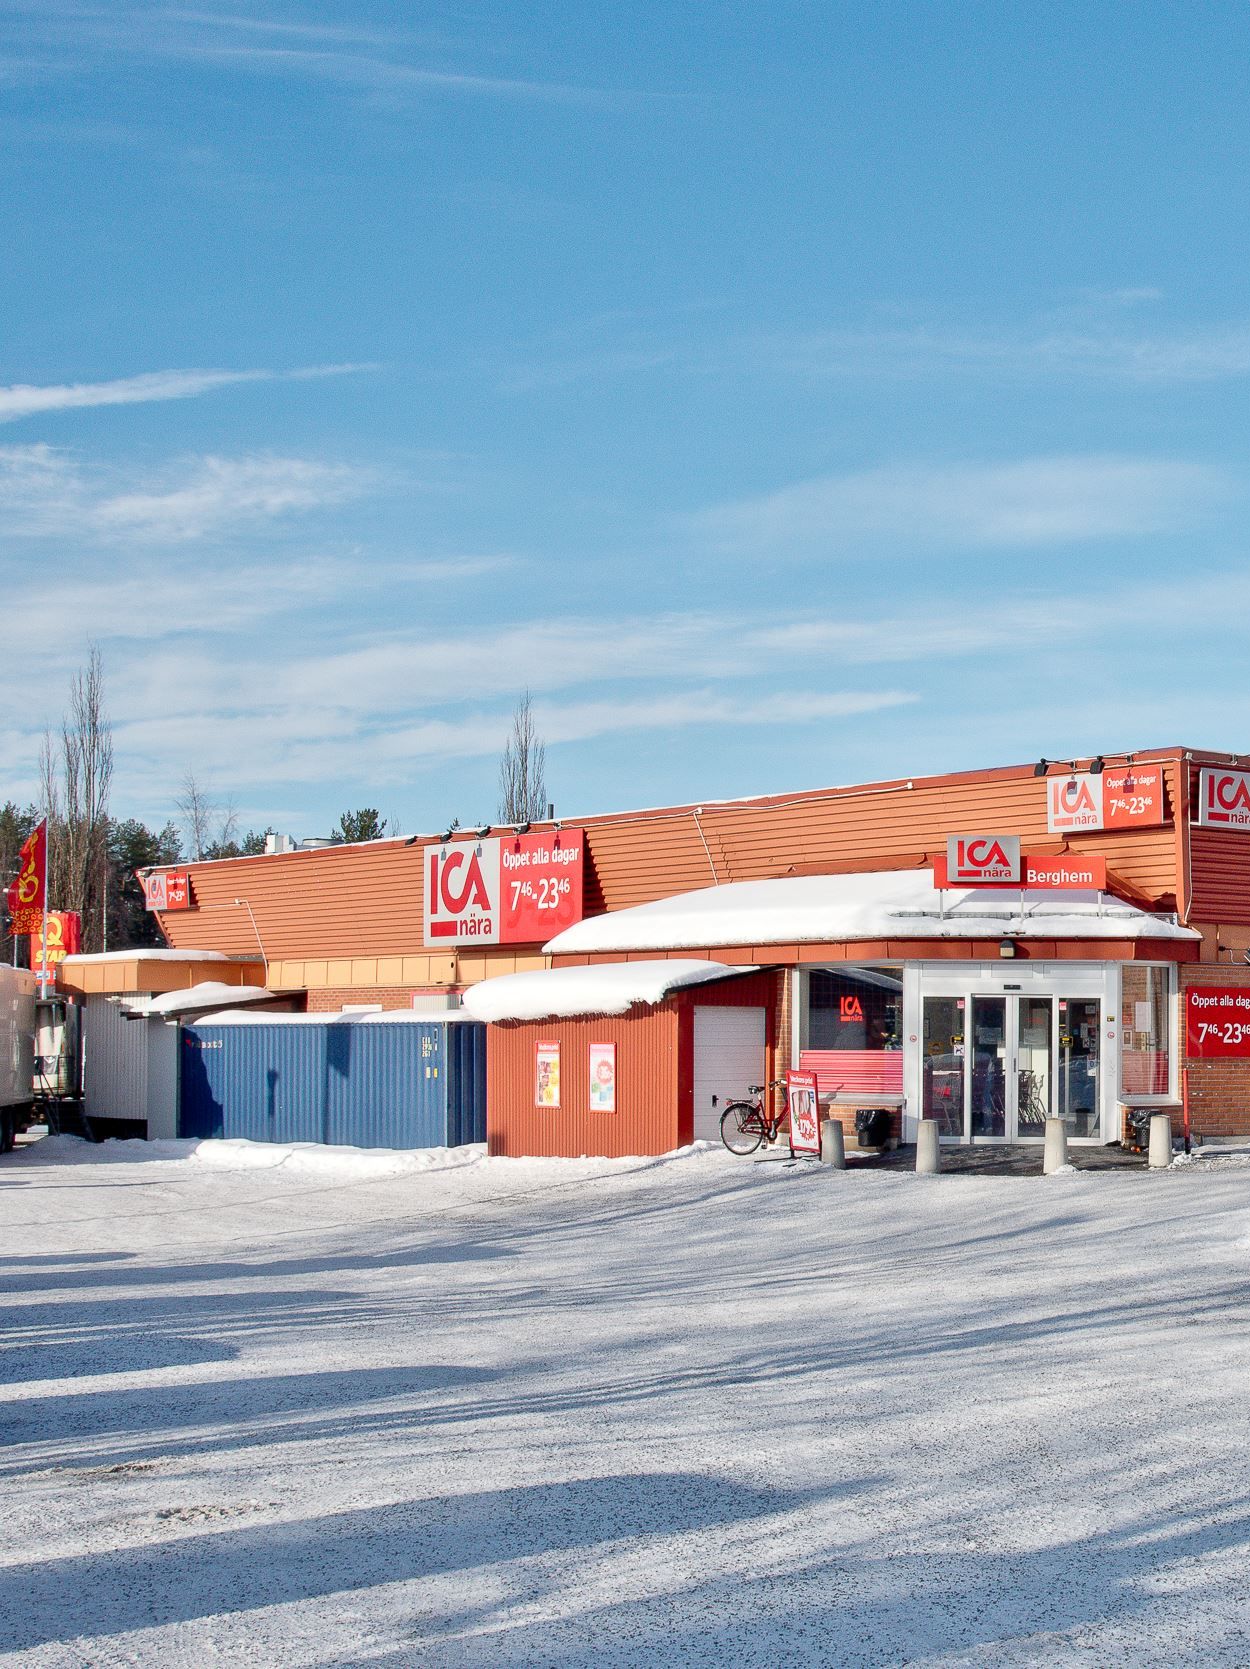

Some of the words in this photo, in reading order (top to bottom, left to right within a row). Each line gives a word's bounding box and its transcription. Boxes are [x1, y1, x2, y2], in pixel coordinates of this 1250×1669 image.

[1106, 777, 1126, 789] Öppet
[1127, 774, 1138, 785] alla
[1139, 774, 1157, 786] dagar
[1053, 780, 1097, 815] ICA
[1074, 812, 1098, 825] nära
[503, 848, 530, 870] Öppet
[532, 847, 550, 865] alla
[552, 846, 580, 867] dagar
[957, 840, 1011, 867] ICA
[430, 850, 491, 914] ICA
[983, 867, 1012, 878] nära
[1027, 868, 1092, 886] Berghem
[459, 913, 492, 936] nära
[840, 996, 863, 1016] ICA
[1191, 992, 1218, 1009] Öppet
[1219, 994, 1234, 1006] alla
